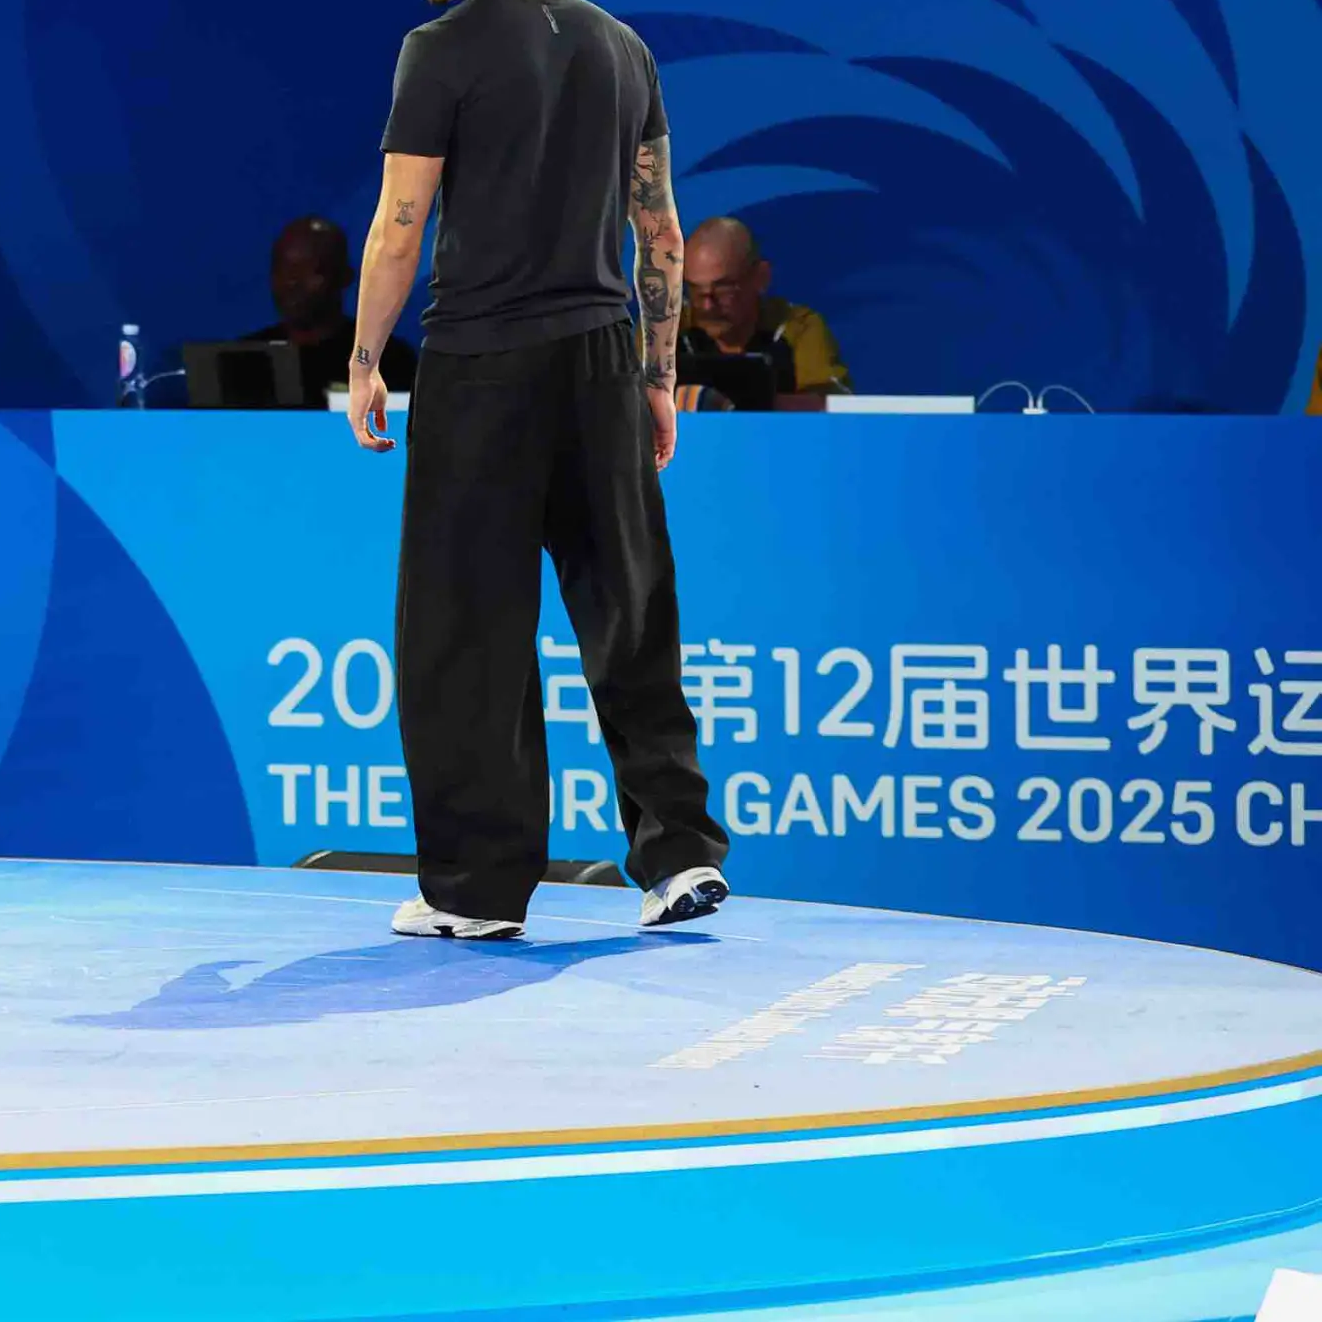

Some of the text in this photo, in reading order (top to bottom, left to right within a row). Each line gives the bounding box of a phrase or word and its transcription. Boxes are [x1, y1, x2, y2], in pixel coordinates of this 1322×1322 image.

[268, 764, 406, 826] THE
[726, 772, 995, 839] GAMES
[1018, 778, 1214, 844] 2025
